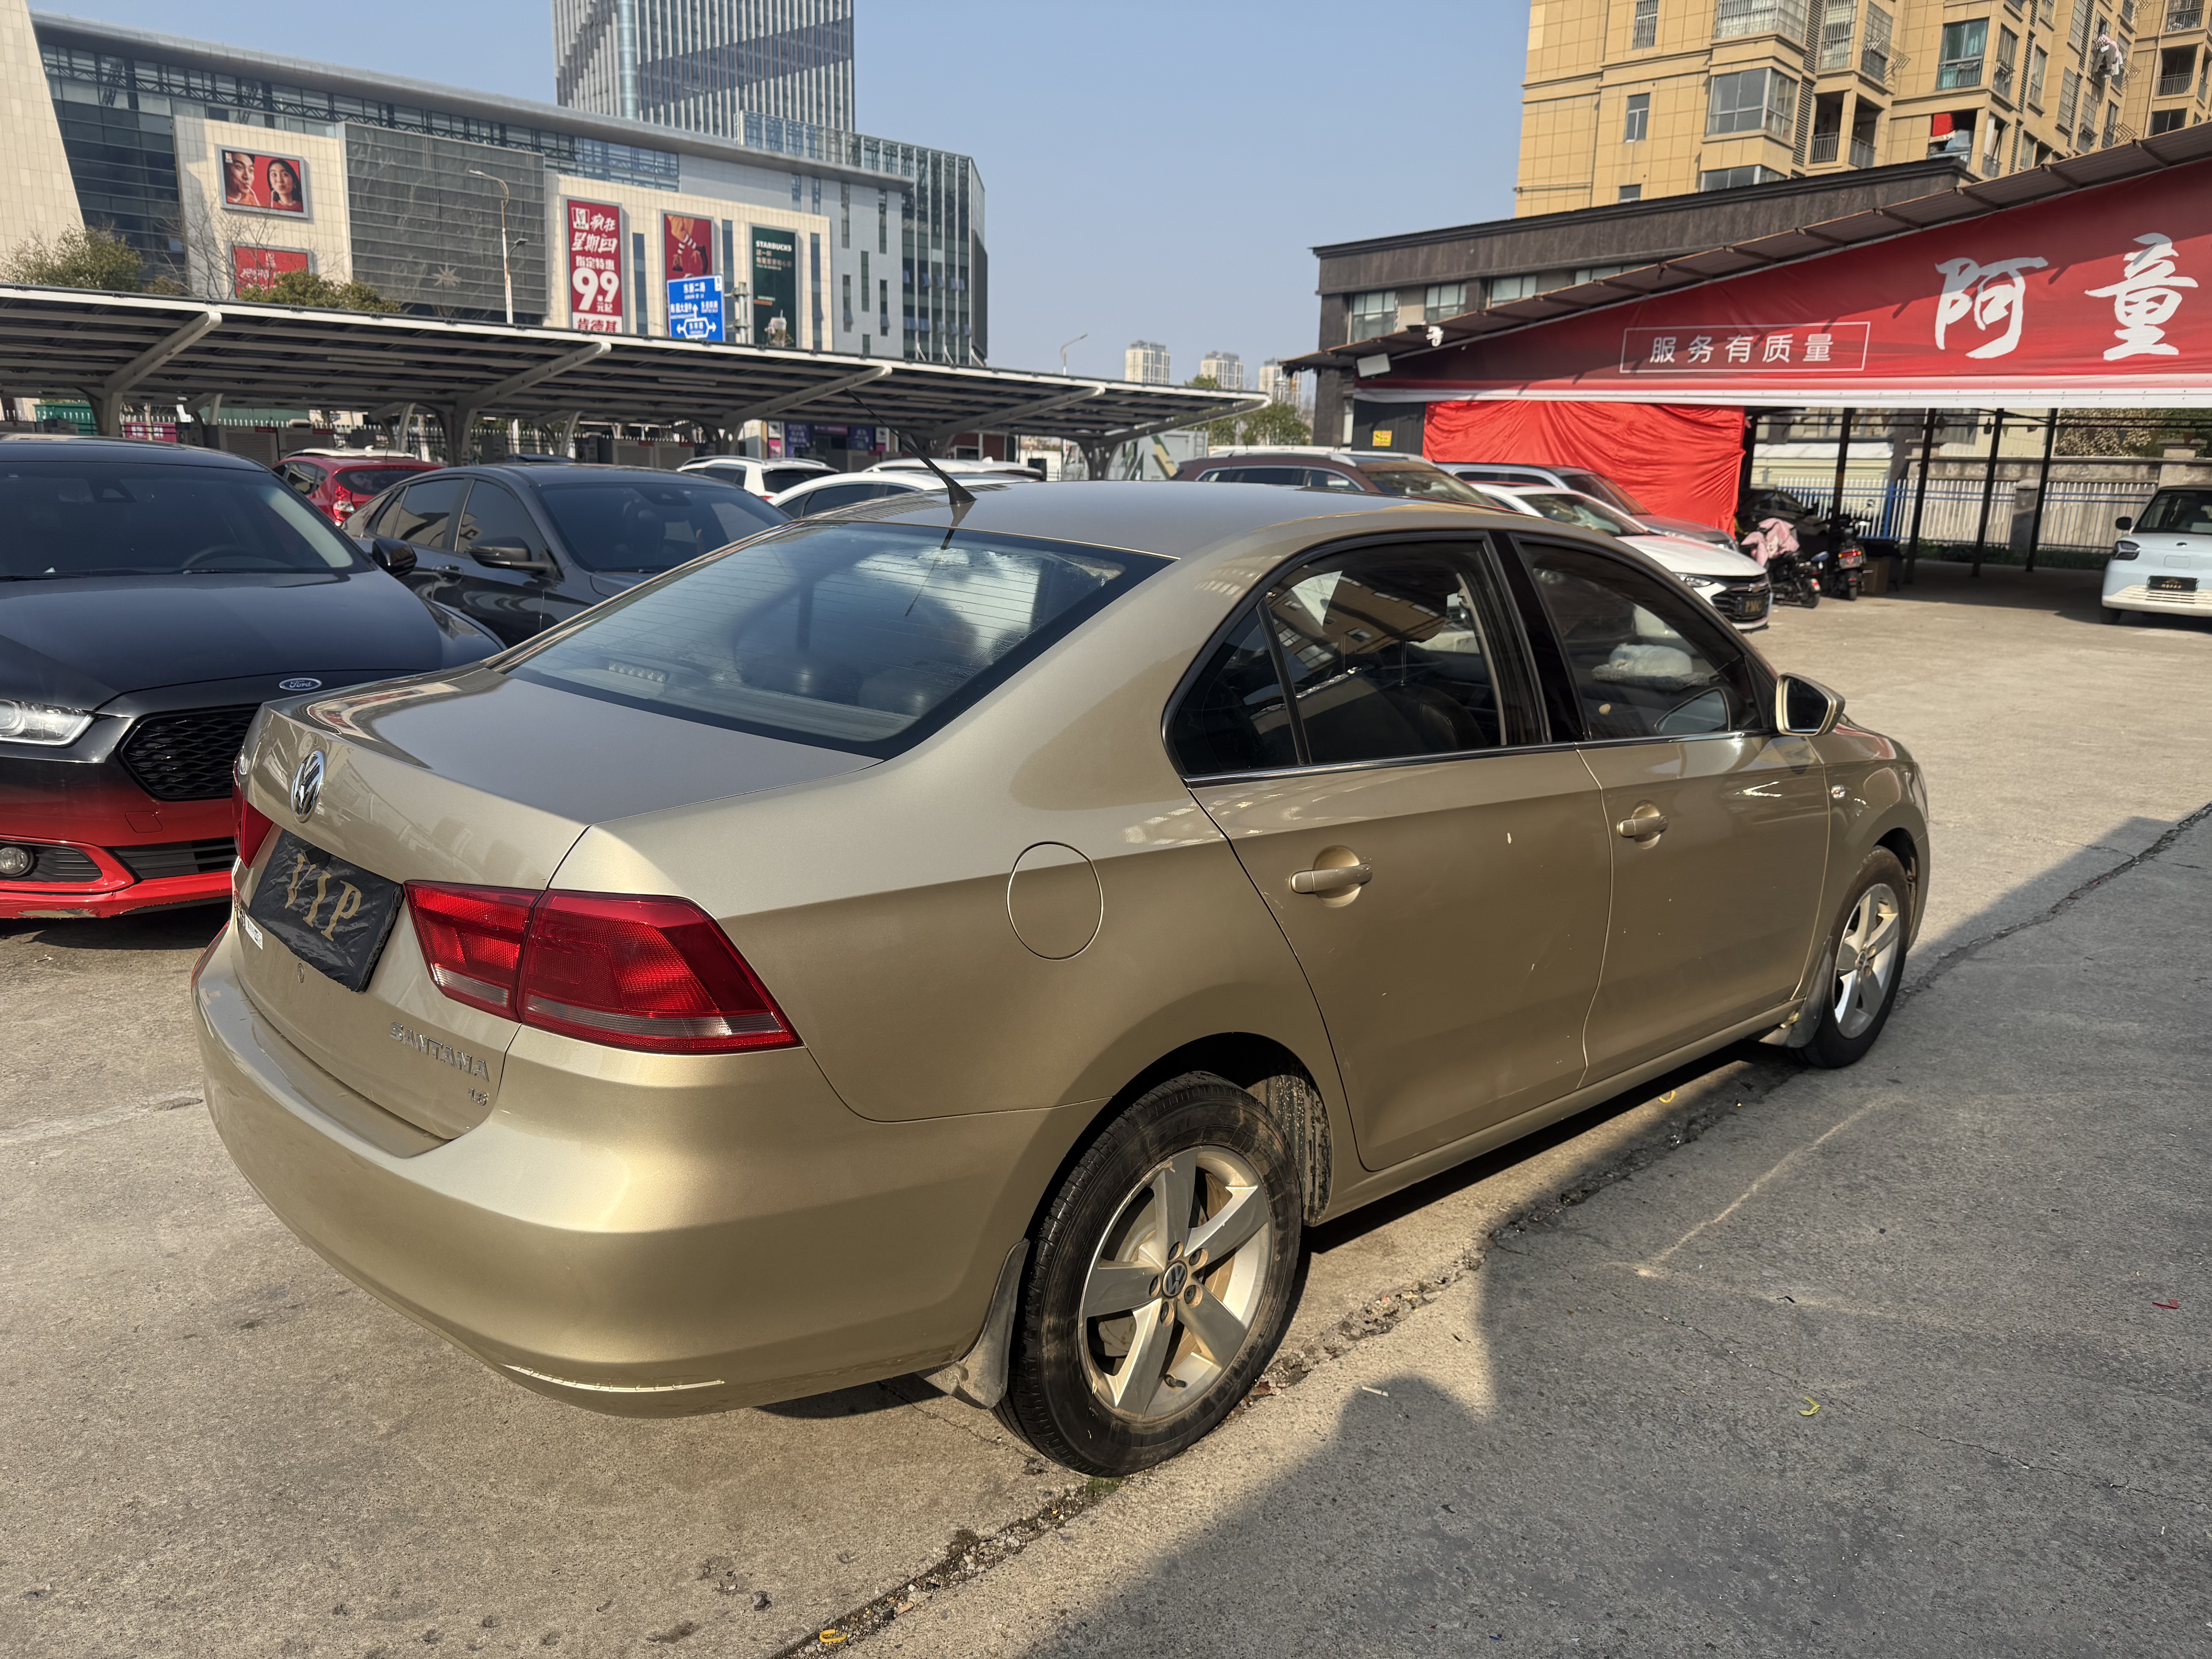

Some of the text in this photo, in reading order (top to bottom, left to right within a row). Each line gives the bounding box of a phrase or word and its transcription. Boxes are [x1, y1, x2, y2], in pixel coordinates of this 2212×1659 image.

[590, 213, 616, 232] 疯狂
[571, 231, 618, 254] 星期四
[756, 240, 792, 252] STARBUCKS
[572, 267, 619, 311] 9.9
[1935, 233, 2198, 361] 阿童
[1649, 333, 1834, 363] 服务有质量
[289, 680, 312, 688] Ford
[285, 853, 361, 942] VIP
[390, 1022, 490, 1082] SANTANA
[467, 1087, 489, 1106] 1.6
